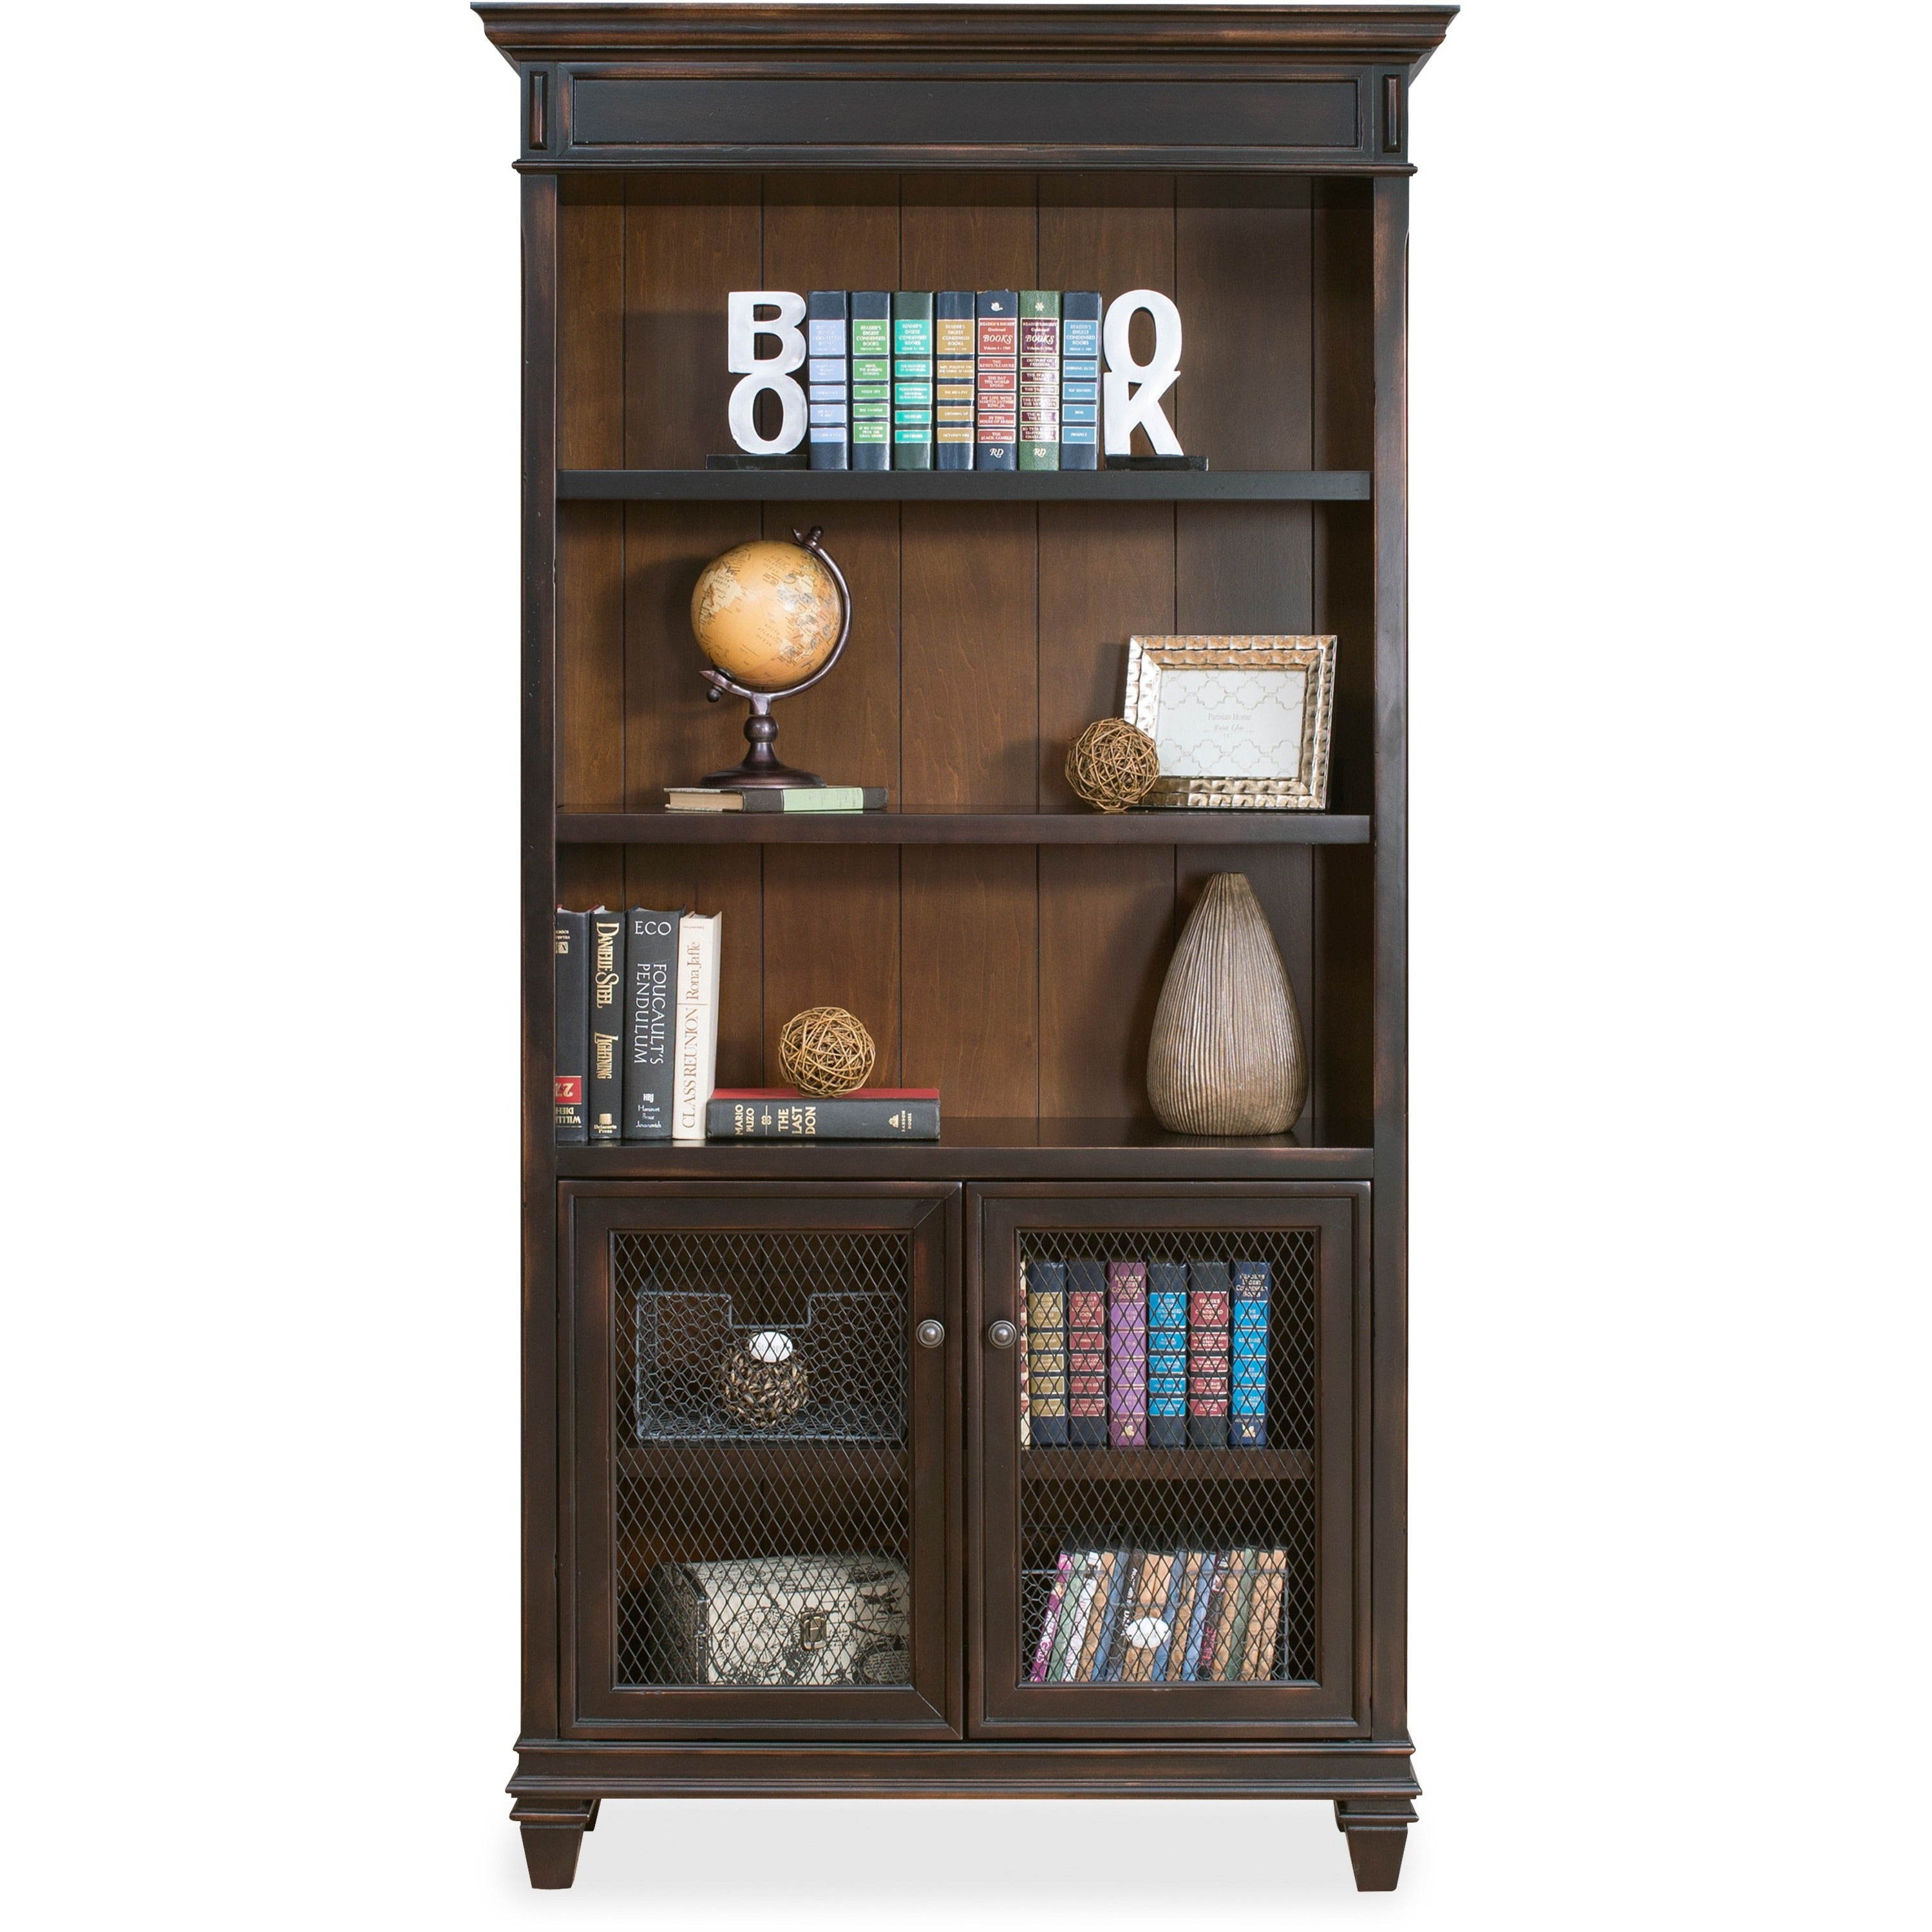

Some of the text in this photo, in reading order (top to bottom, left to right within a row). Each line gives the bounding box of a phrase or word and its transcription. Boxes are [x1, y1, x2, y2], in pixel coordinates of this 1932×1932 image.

[983, 334, 1013, 345] BOOKS
[1025, 334, 1055, 345] BOOKS
[634, 920, 672, 936] ECO
[687, 942, 701, 969] Jaffe
[686, 969, 699, 1001] Rona
[634, 963, 650, 1063] PENDULUM
[649, 963, 667, 1065] FOUCAULT'S
[681, 1008, 699, 1128] CLASS REUNION
[556, 1115, 582, 1124] WILLI
[735, 1104, 744, 1135] MARIO
[746, 1108, 755, 1132] PUZO
[778, 1108, 789, 1132] THE
[791, 1106, 802, 1134] LAST
[804, 1106, 816, 1135] DON
